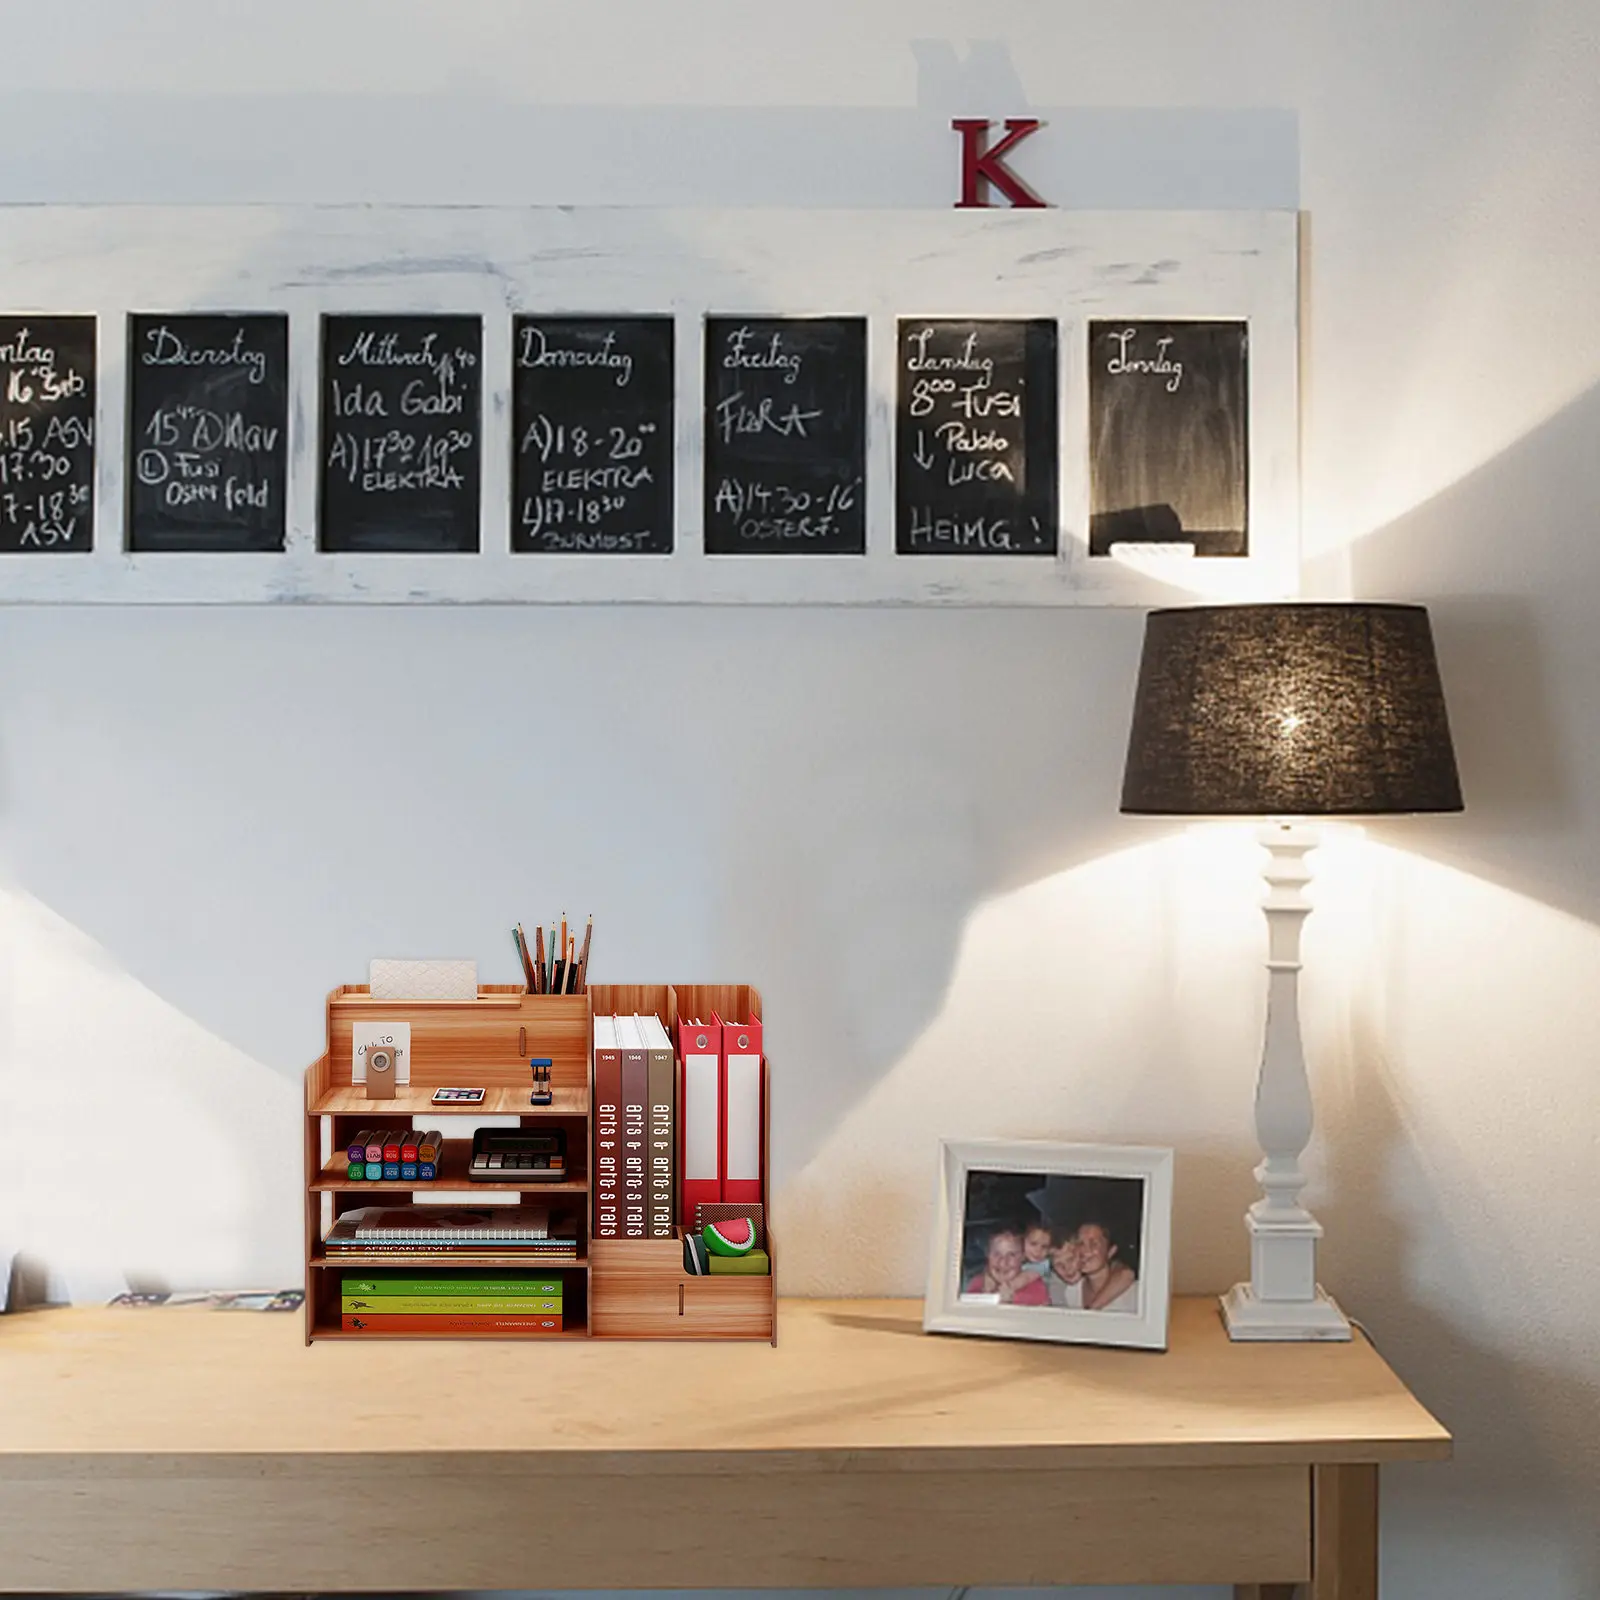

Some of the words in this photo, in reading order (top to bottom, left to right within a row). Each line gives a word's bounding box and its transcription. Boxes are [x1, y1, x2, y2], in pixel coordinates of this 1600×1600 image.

[952, 118, 1050, 208] K
[362, 465, 465, 492] ELEKTRA
[542, 464, 654, 492] ELEKTRA
[600, 1104, 617, 1135] arts
[626, 1104, 644, 1135] arts
[653, 1104, 670, 1135] arts
[600, 1142, 615, 1150] &
[626, 1142, 642, 1150] &
[653, 1142, 668, 1150] &
[600, 1206, 617, 1236] rats
[627, 1206, 644, 1236] rats
[654, 1206, 670, 1236] rats
